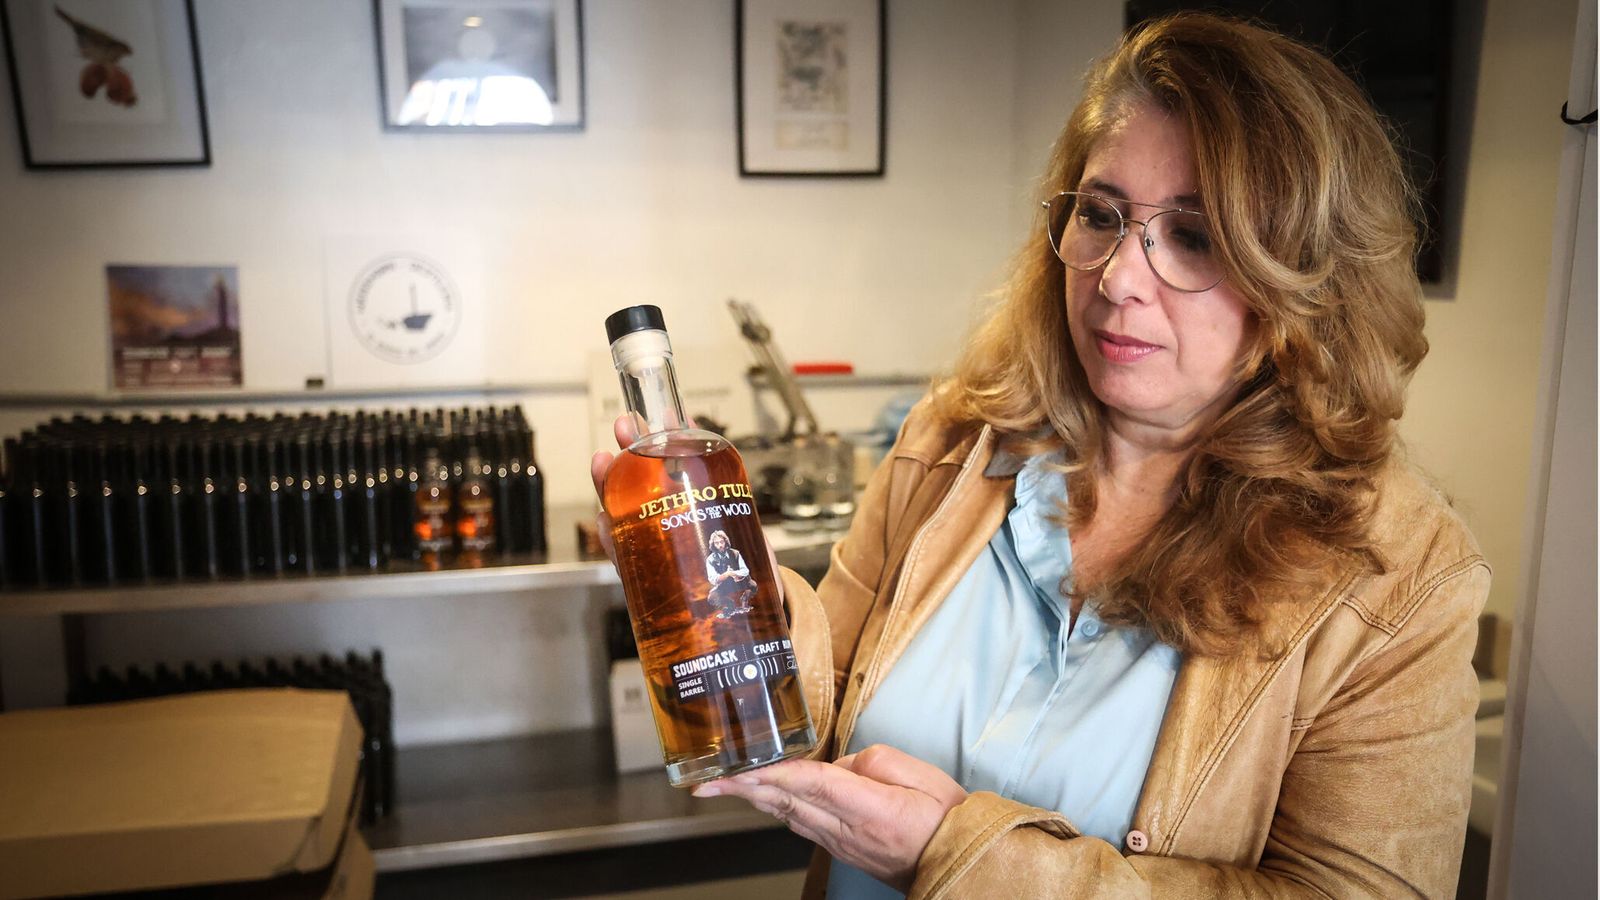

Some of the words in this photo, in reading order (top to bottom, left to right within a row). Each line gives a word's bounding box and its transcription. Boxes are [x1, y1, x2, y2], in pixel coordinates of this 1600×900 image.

[639, 486, 717, 519] JETHRO
[718, 484, 753, 499] TULL
[661, 509, 707, 531] SONGS
[721, 503, 751, 516] WOOD
[673, 649, 738, 678] SOUNDCASK
[753, 641, 780, 655] CRAFT
[678, 677, 703, 690] SINGLE
[680, 686, 705, 698] BARREL
